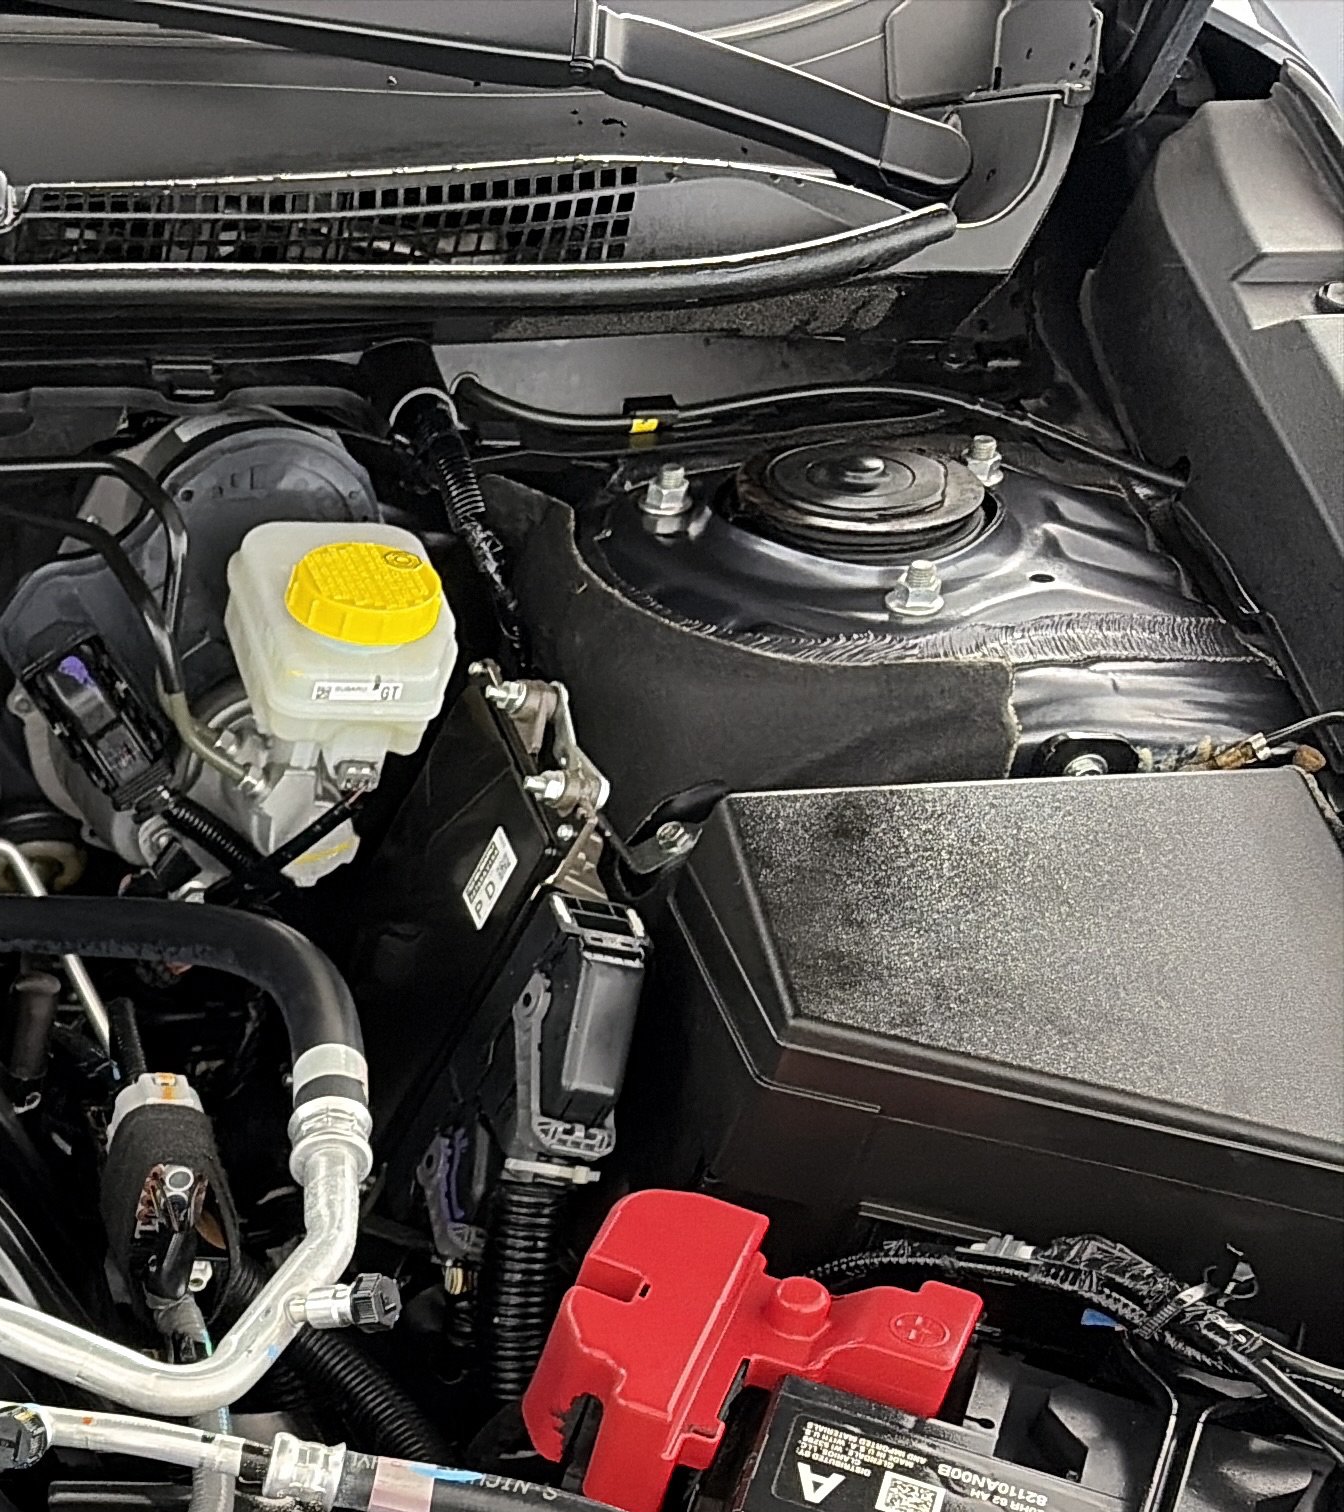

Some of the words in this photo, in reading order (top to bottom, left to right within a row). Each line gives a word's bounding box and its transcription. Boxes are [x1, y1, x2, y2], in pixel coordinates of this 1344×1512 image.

[811, 1452, 871, 1476] DISTRIBUTED
[797, 1461, 846, 1504] A
[936, 1463, 1048, 1507] 82110AN00B
[969, 1488, 990, 1501] AH
